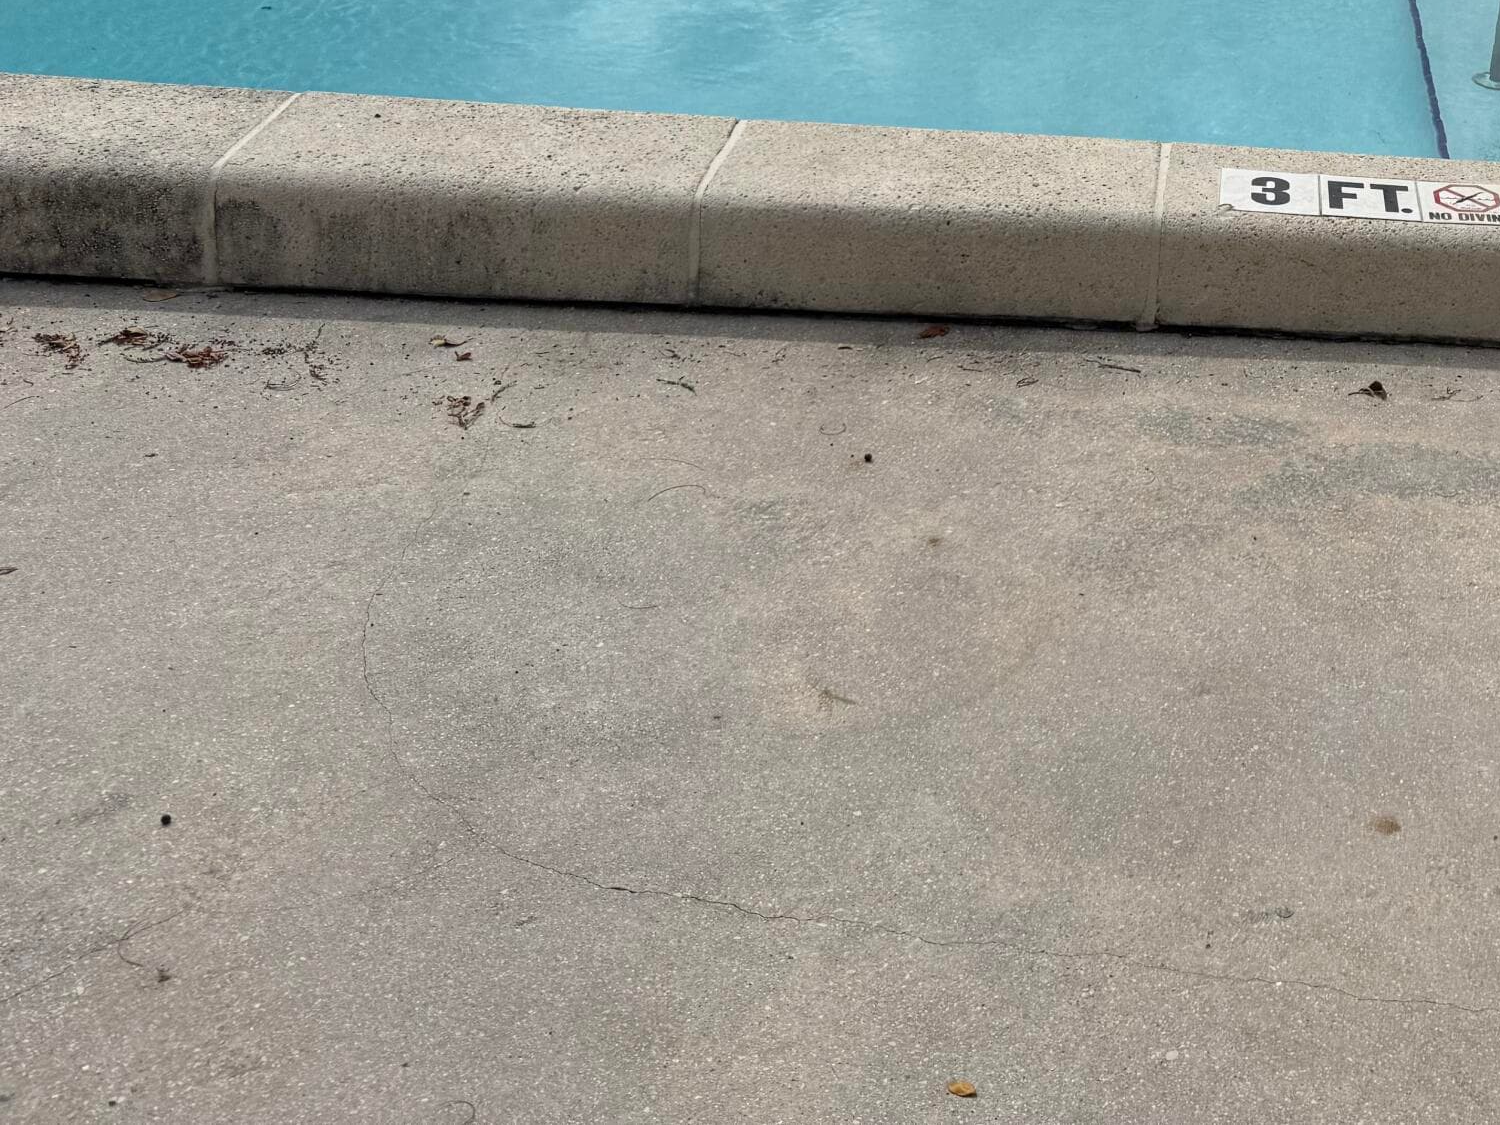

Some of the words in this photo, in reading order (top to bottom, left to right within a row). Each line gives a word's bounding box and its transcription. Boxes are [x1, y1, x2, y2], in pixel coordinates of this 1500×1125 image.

[1250, 176, 1291, 206] 3
[1327, 180, 1414, 214] FT.
[1428, 211, 1453, 221] NO
